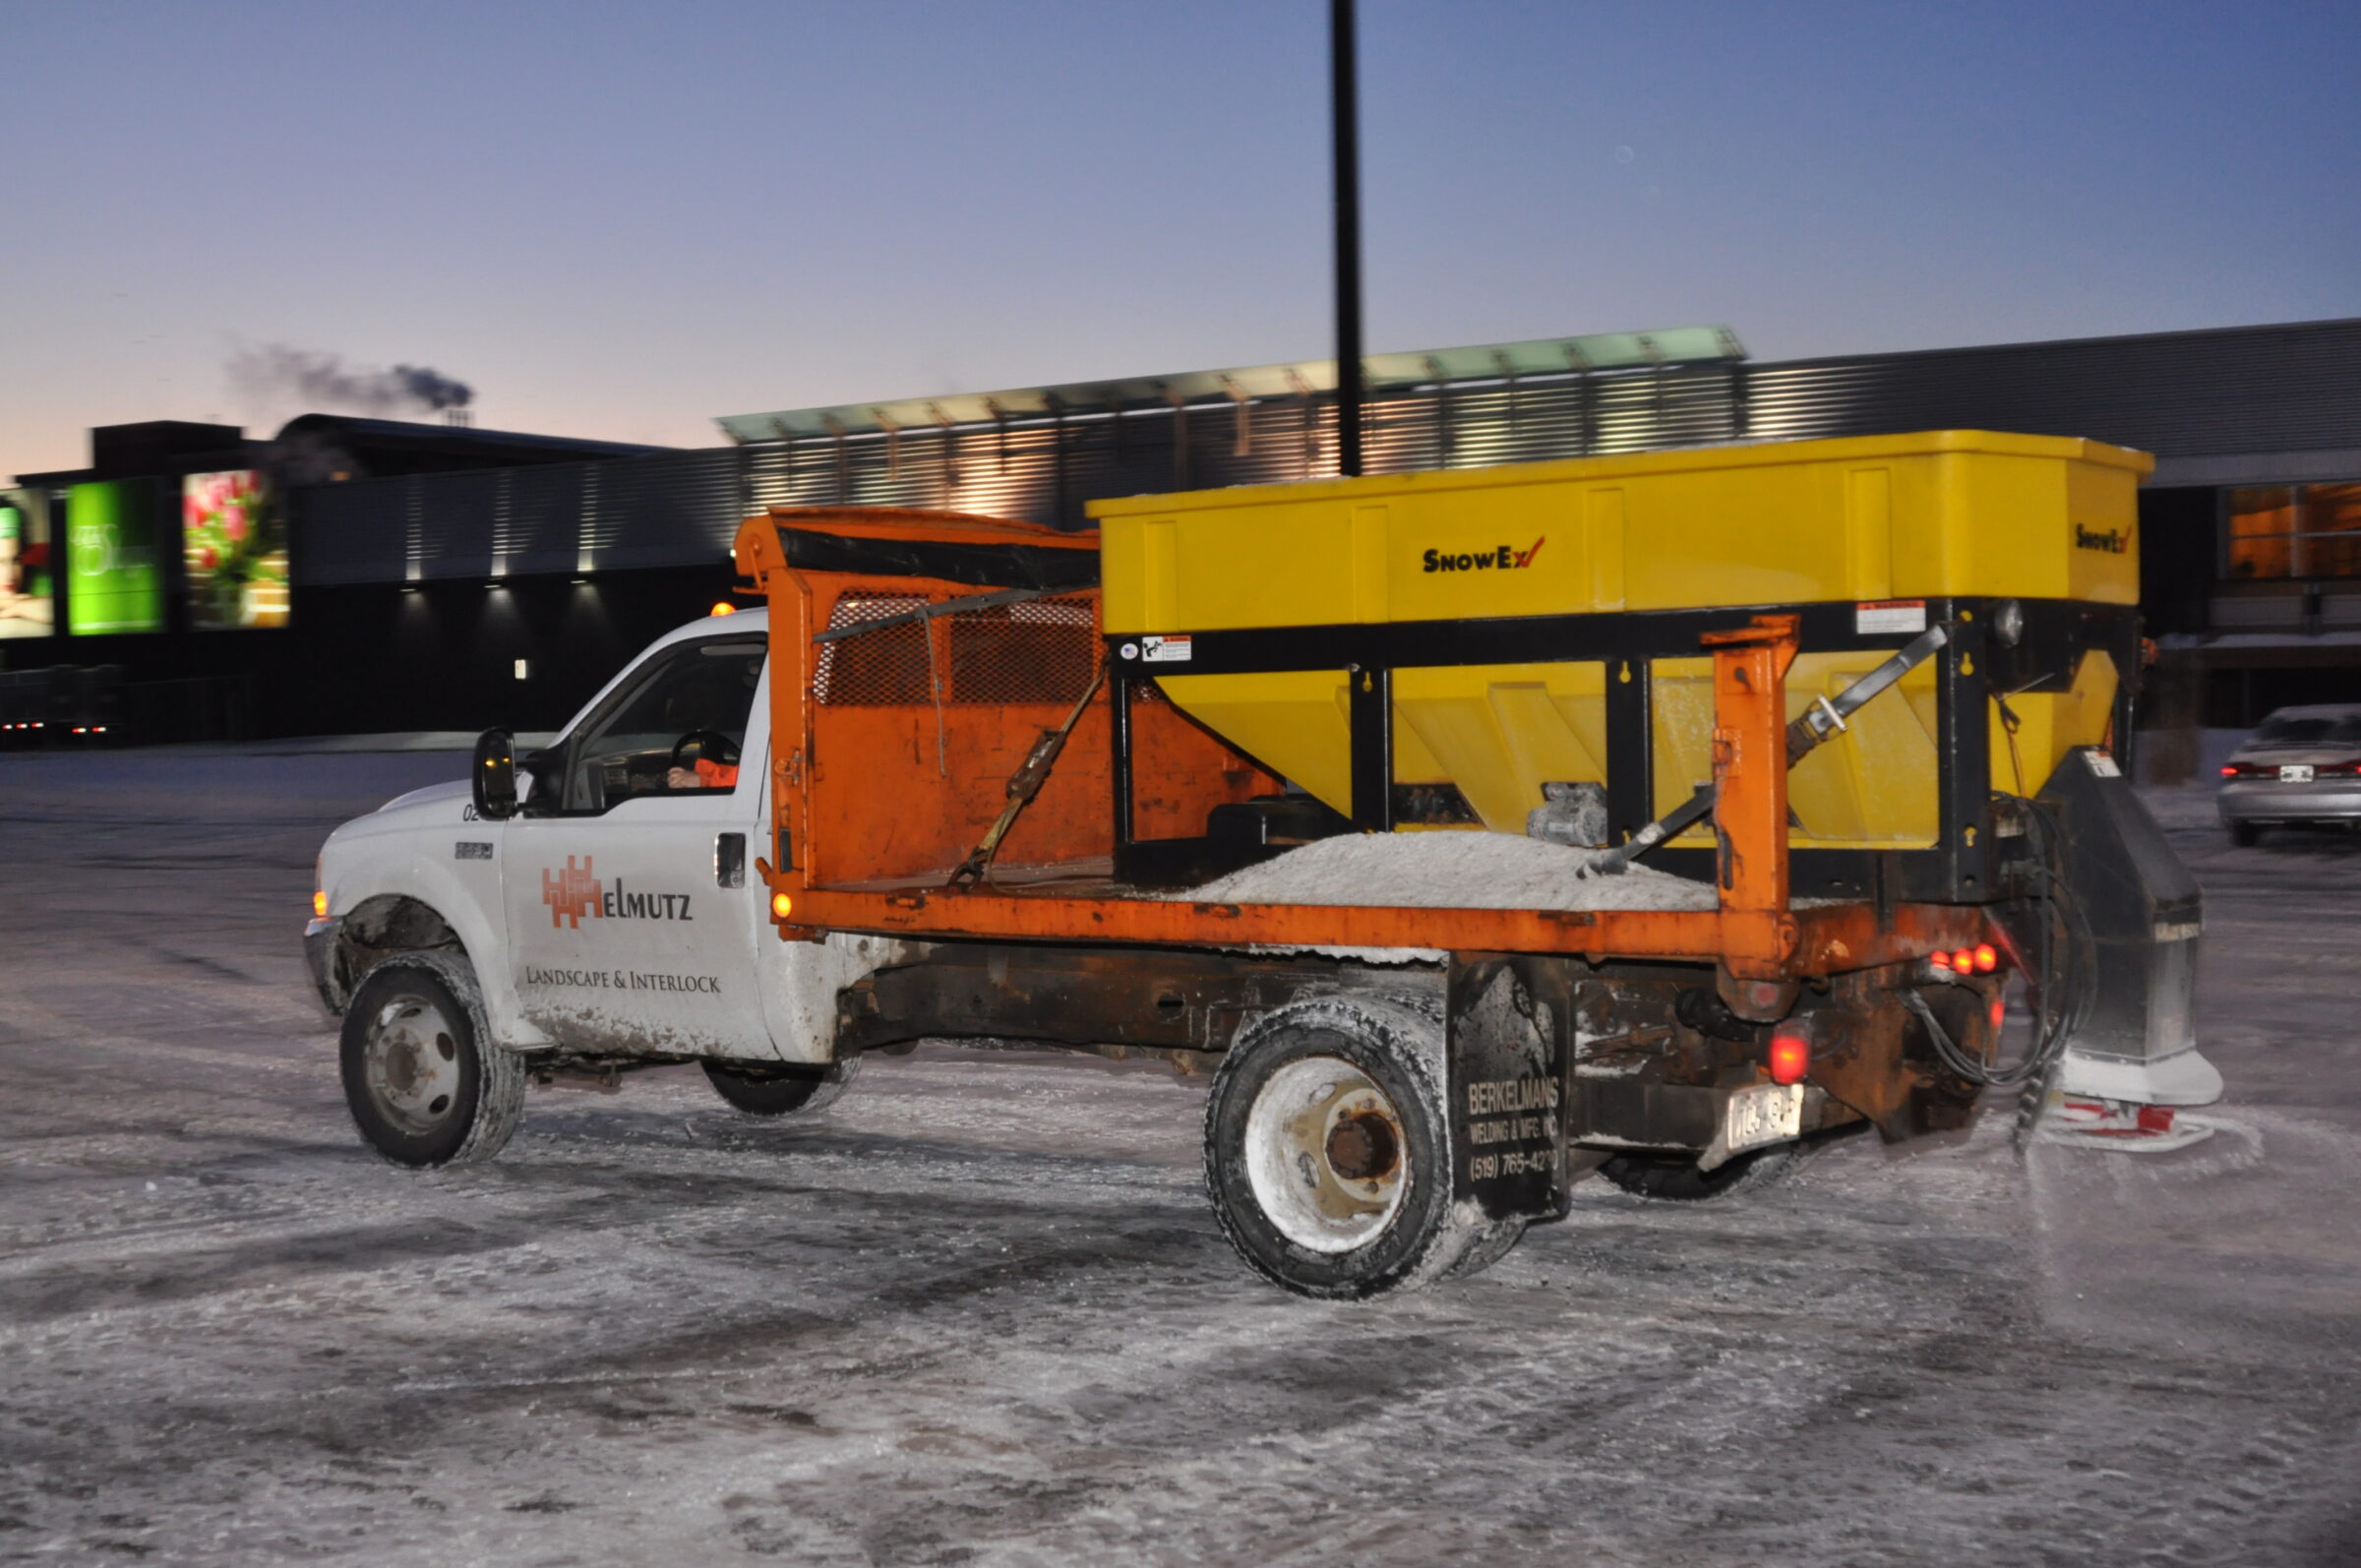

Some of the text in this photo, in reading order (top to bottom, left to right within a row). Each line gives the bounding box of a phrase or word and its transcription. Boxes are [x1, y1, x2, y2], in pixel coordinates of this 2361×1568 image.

[614, 970, 626, 989] &
[1469, 1076, 1559, 1116] BERKELMANS
[1470, 1120, 1509, 1145] WELDING
[1470, 1153, 1498, 1182] (519)
